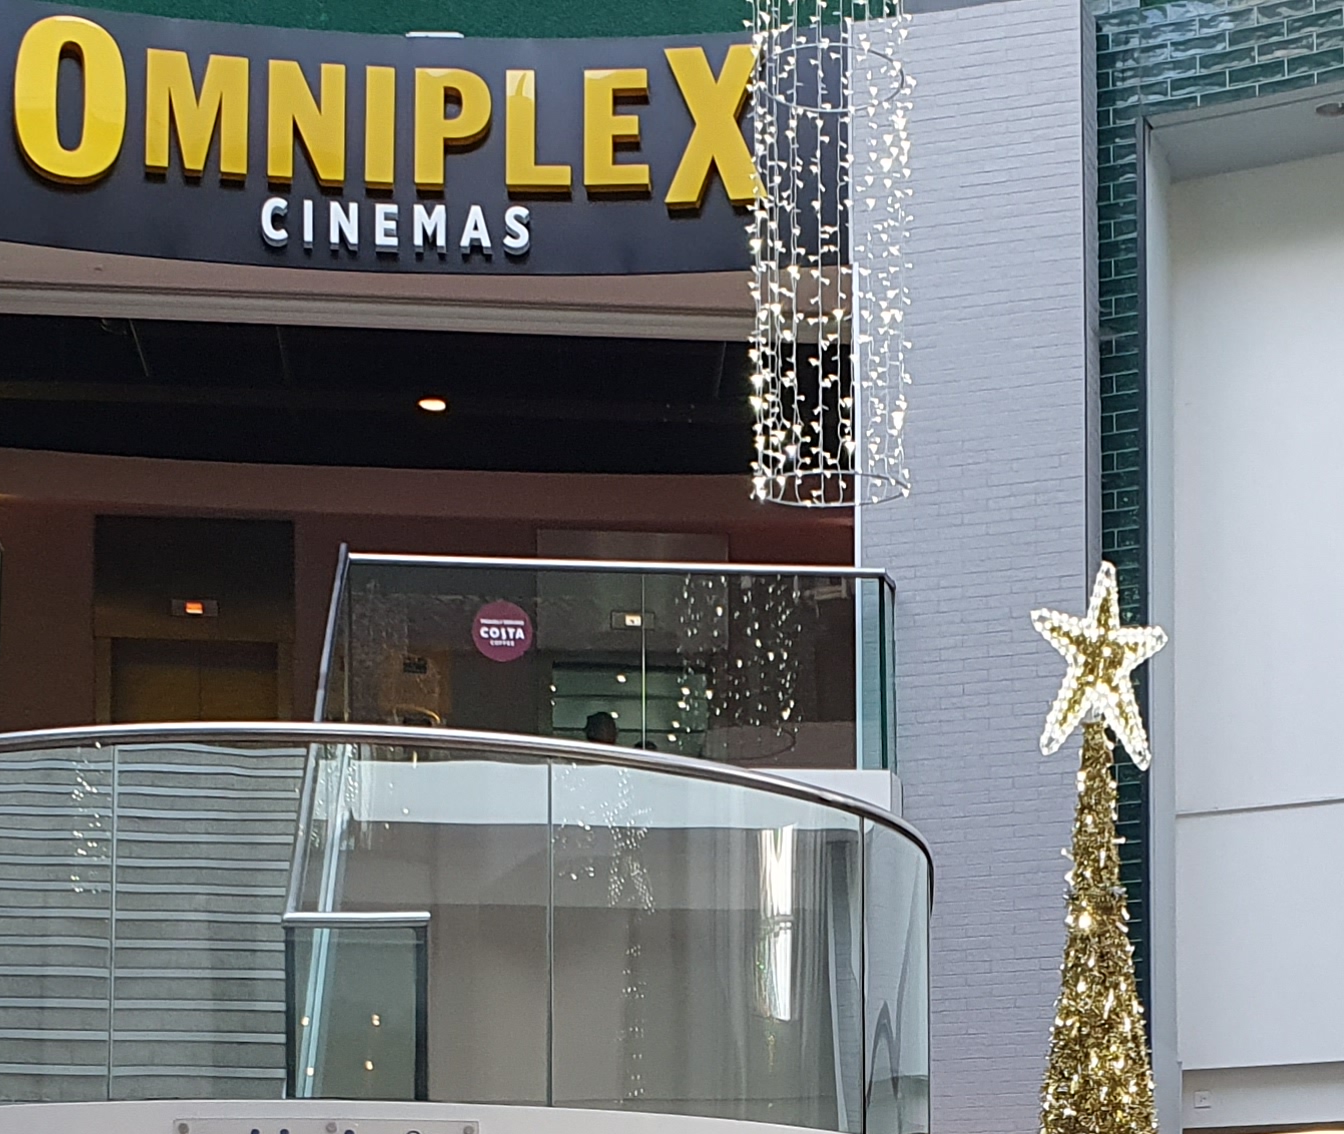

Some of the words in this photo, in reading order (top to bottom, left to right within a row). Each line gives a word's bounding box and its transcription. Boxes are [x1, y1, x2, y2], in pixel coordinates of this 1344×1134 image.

[13, 15, 769, 214] OMNIPLEX
[261, 197, 532, 255] CINEMAS
[480, 626, 525, 640] COSTA
